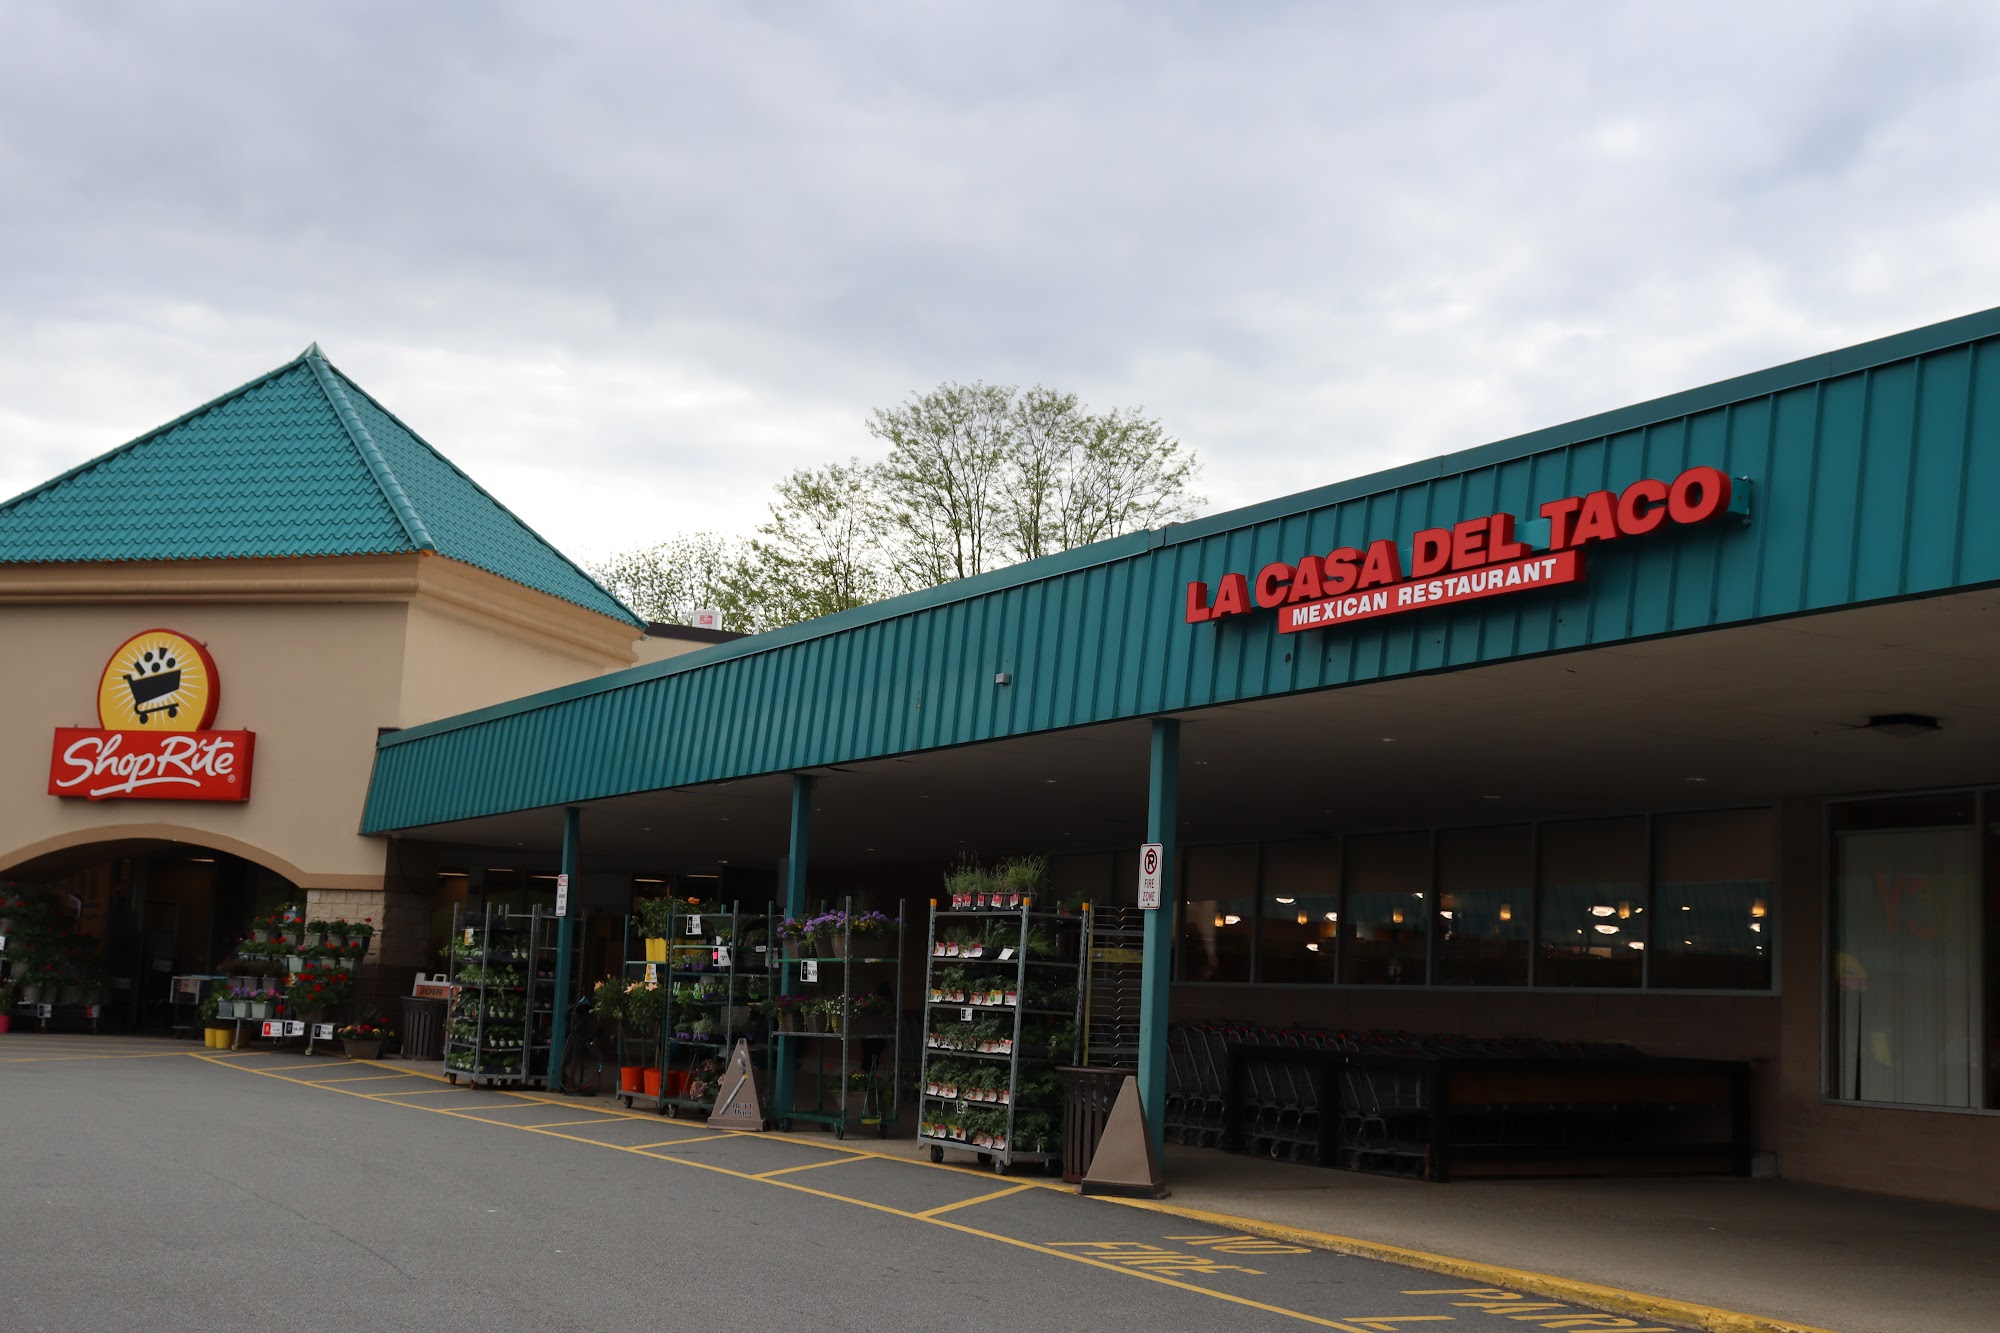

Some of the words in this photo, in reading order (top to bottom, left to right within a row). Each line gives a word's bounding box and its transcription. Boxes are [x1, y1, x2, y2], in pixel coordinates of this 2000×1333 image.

[1186, 573, 1252, 623] LA
[1255, 539, 1402, 608] CASA
[1411, 513, 1532, 578] DEL
[1540, 466, 1732, 551] TACO
[1292, 591, 1388, 626] MEXICAN
[1398, 559, 1558, 607] RESTAURANT
[56, 734, 235, 796] ShopRite
[1142, 891, 1155, 902] ZONE
[1144, 879, 1155, 888] FIRE
[419, 986, 443, 995] JOIN
[1044, 1241, 1268, 1276] FIRE
[1163, 1235, 1312, 1254] NO
[1400, 1288, 1678, 1333] PAR
